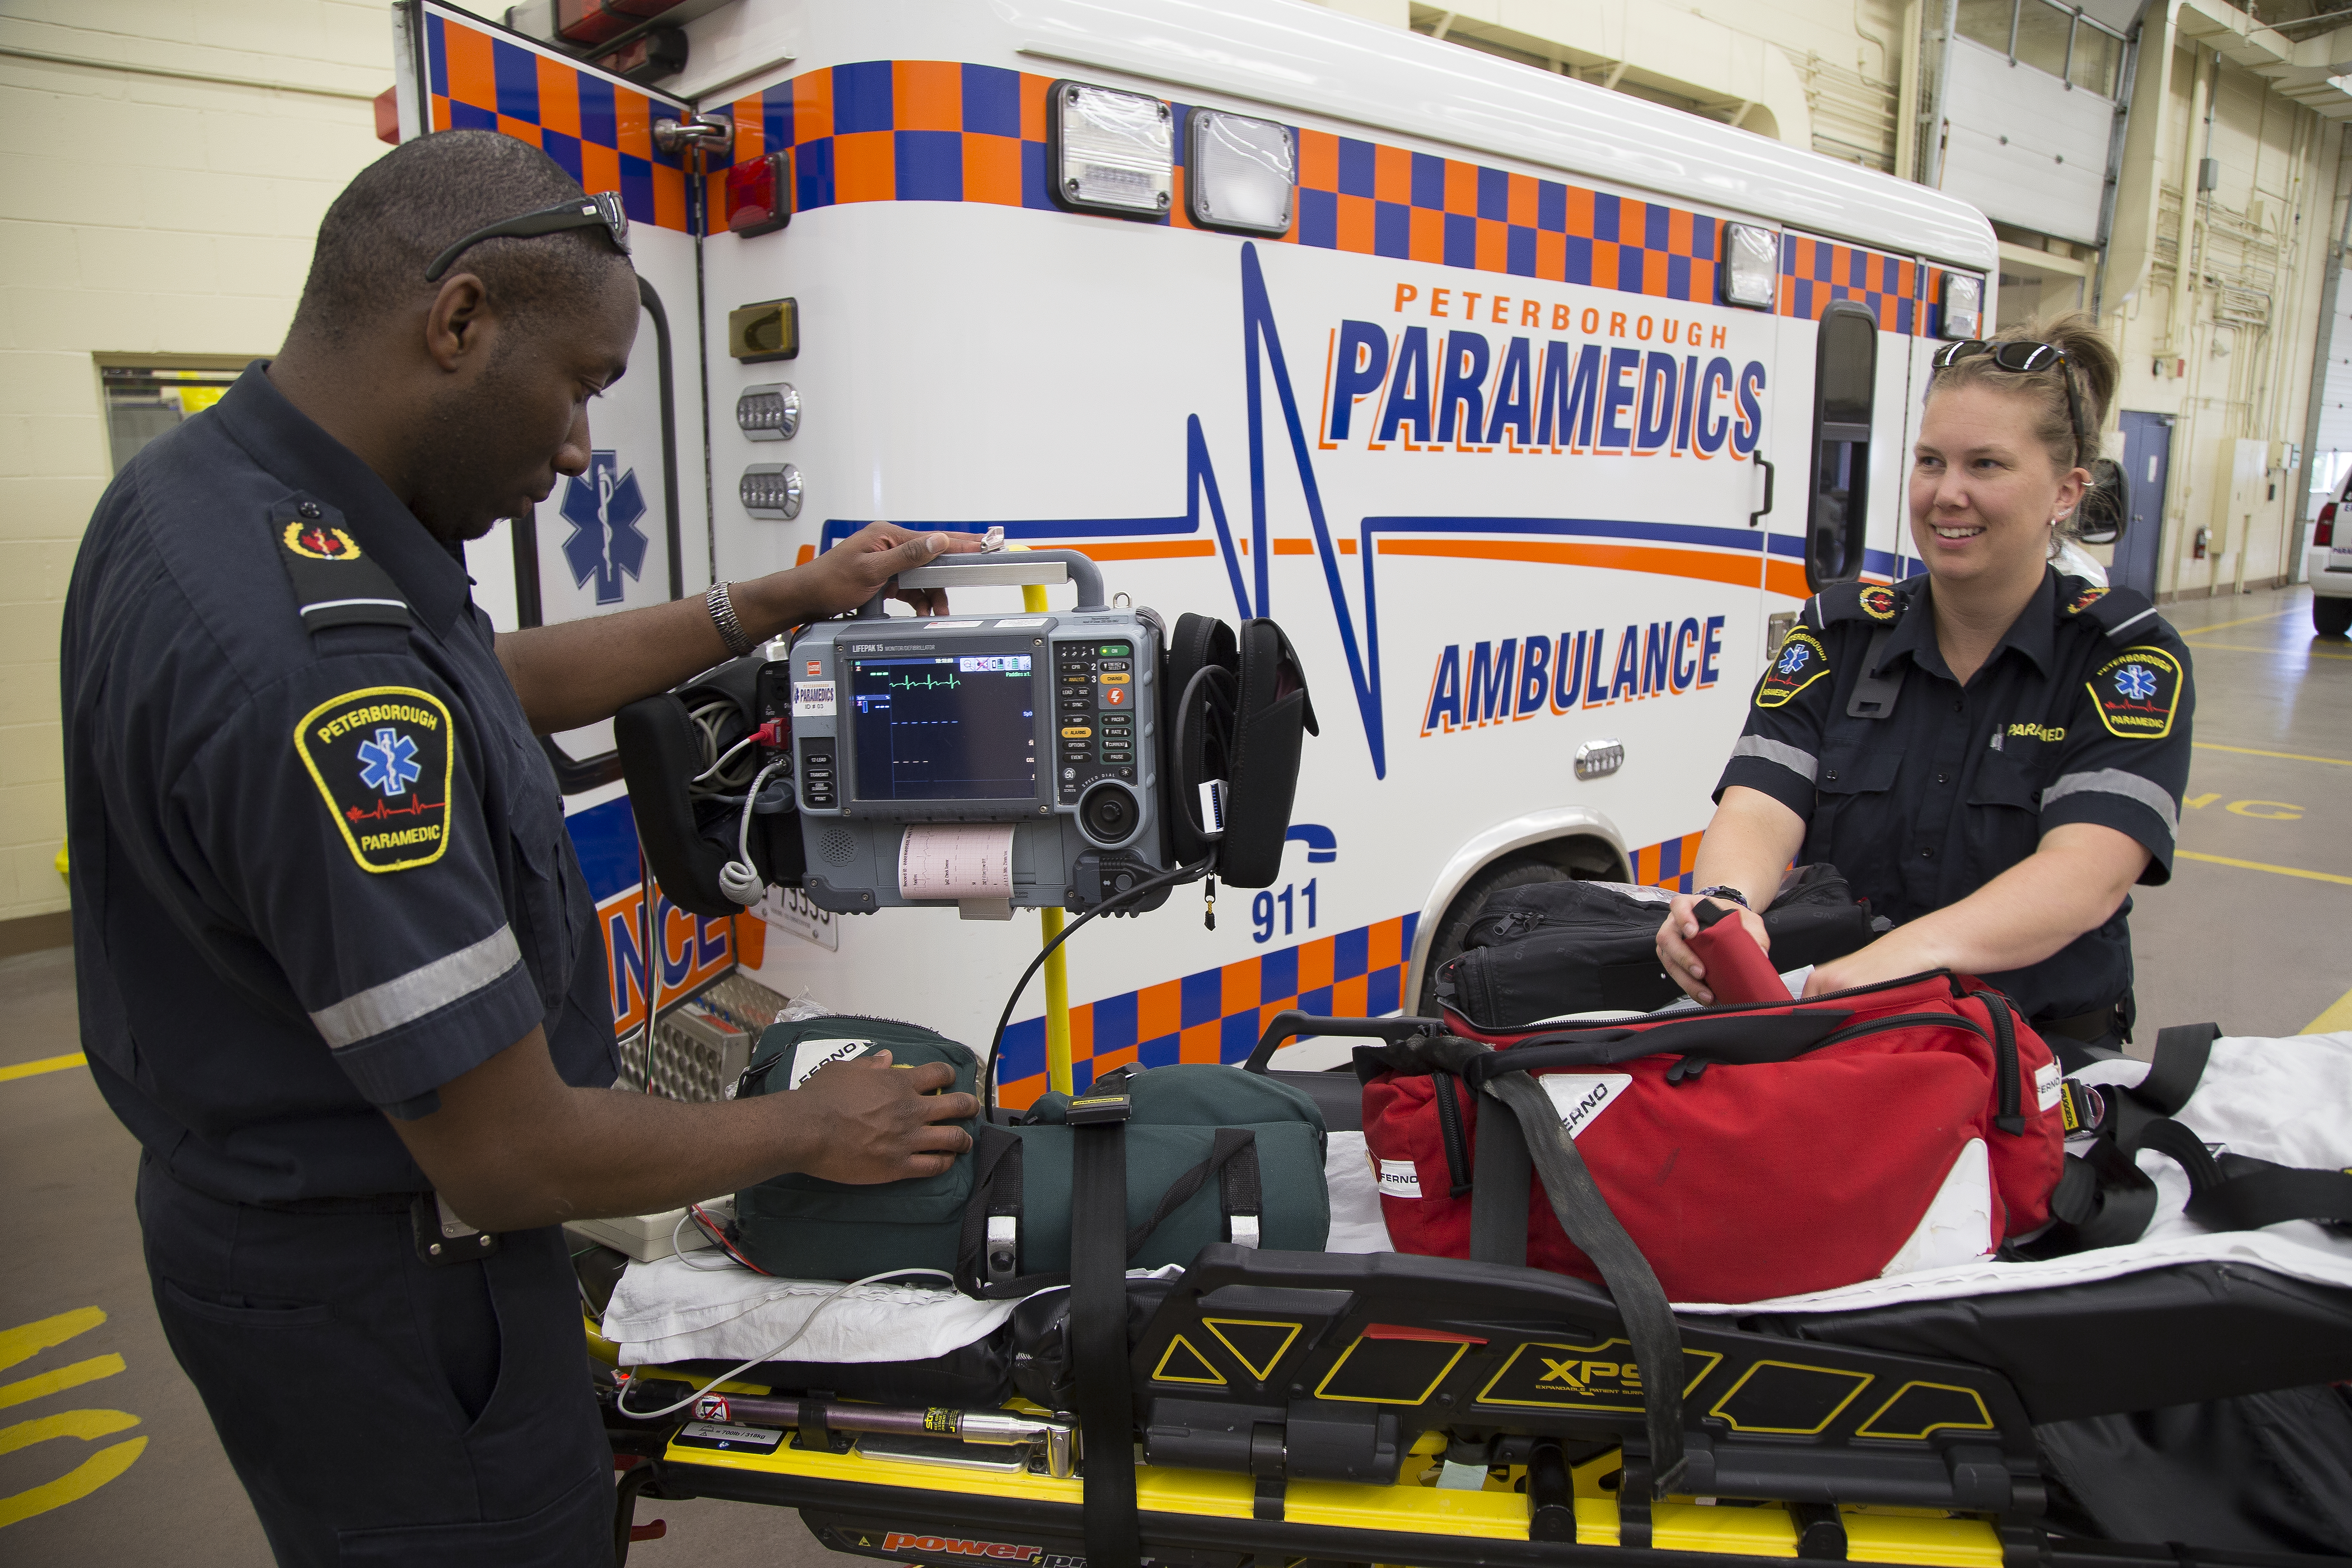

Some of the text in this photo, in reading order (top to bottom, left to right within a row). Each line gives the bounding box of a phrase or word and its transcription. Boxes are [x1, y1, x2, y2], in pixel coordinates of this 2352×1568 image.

[1394, 283, 1726, 349] PETERBOROUGH
[1319, 319, 1766, 460] PARAMEDICS
[1421, 615, 1725, 738] AMBULANCE
[800, 688, 834, 703] PARAMEDICS
[317, 703, 438, 745] PETERBOROUGH
[2111, 715, 2164, 728] PARAMEDIC
[1081, 776, 1099, 788] SPEED
[361, 824, 441, 851] PARAMEDIC
[1252, 878, 1318, 944] 911
[1562, 1083, 1608, 1132] ERNO
[1381, 1172, 1418, 1184] FERNO
[882, 1532, 1042, 1560] power
